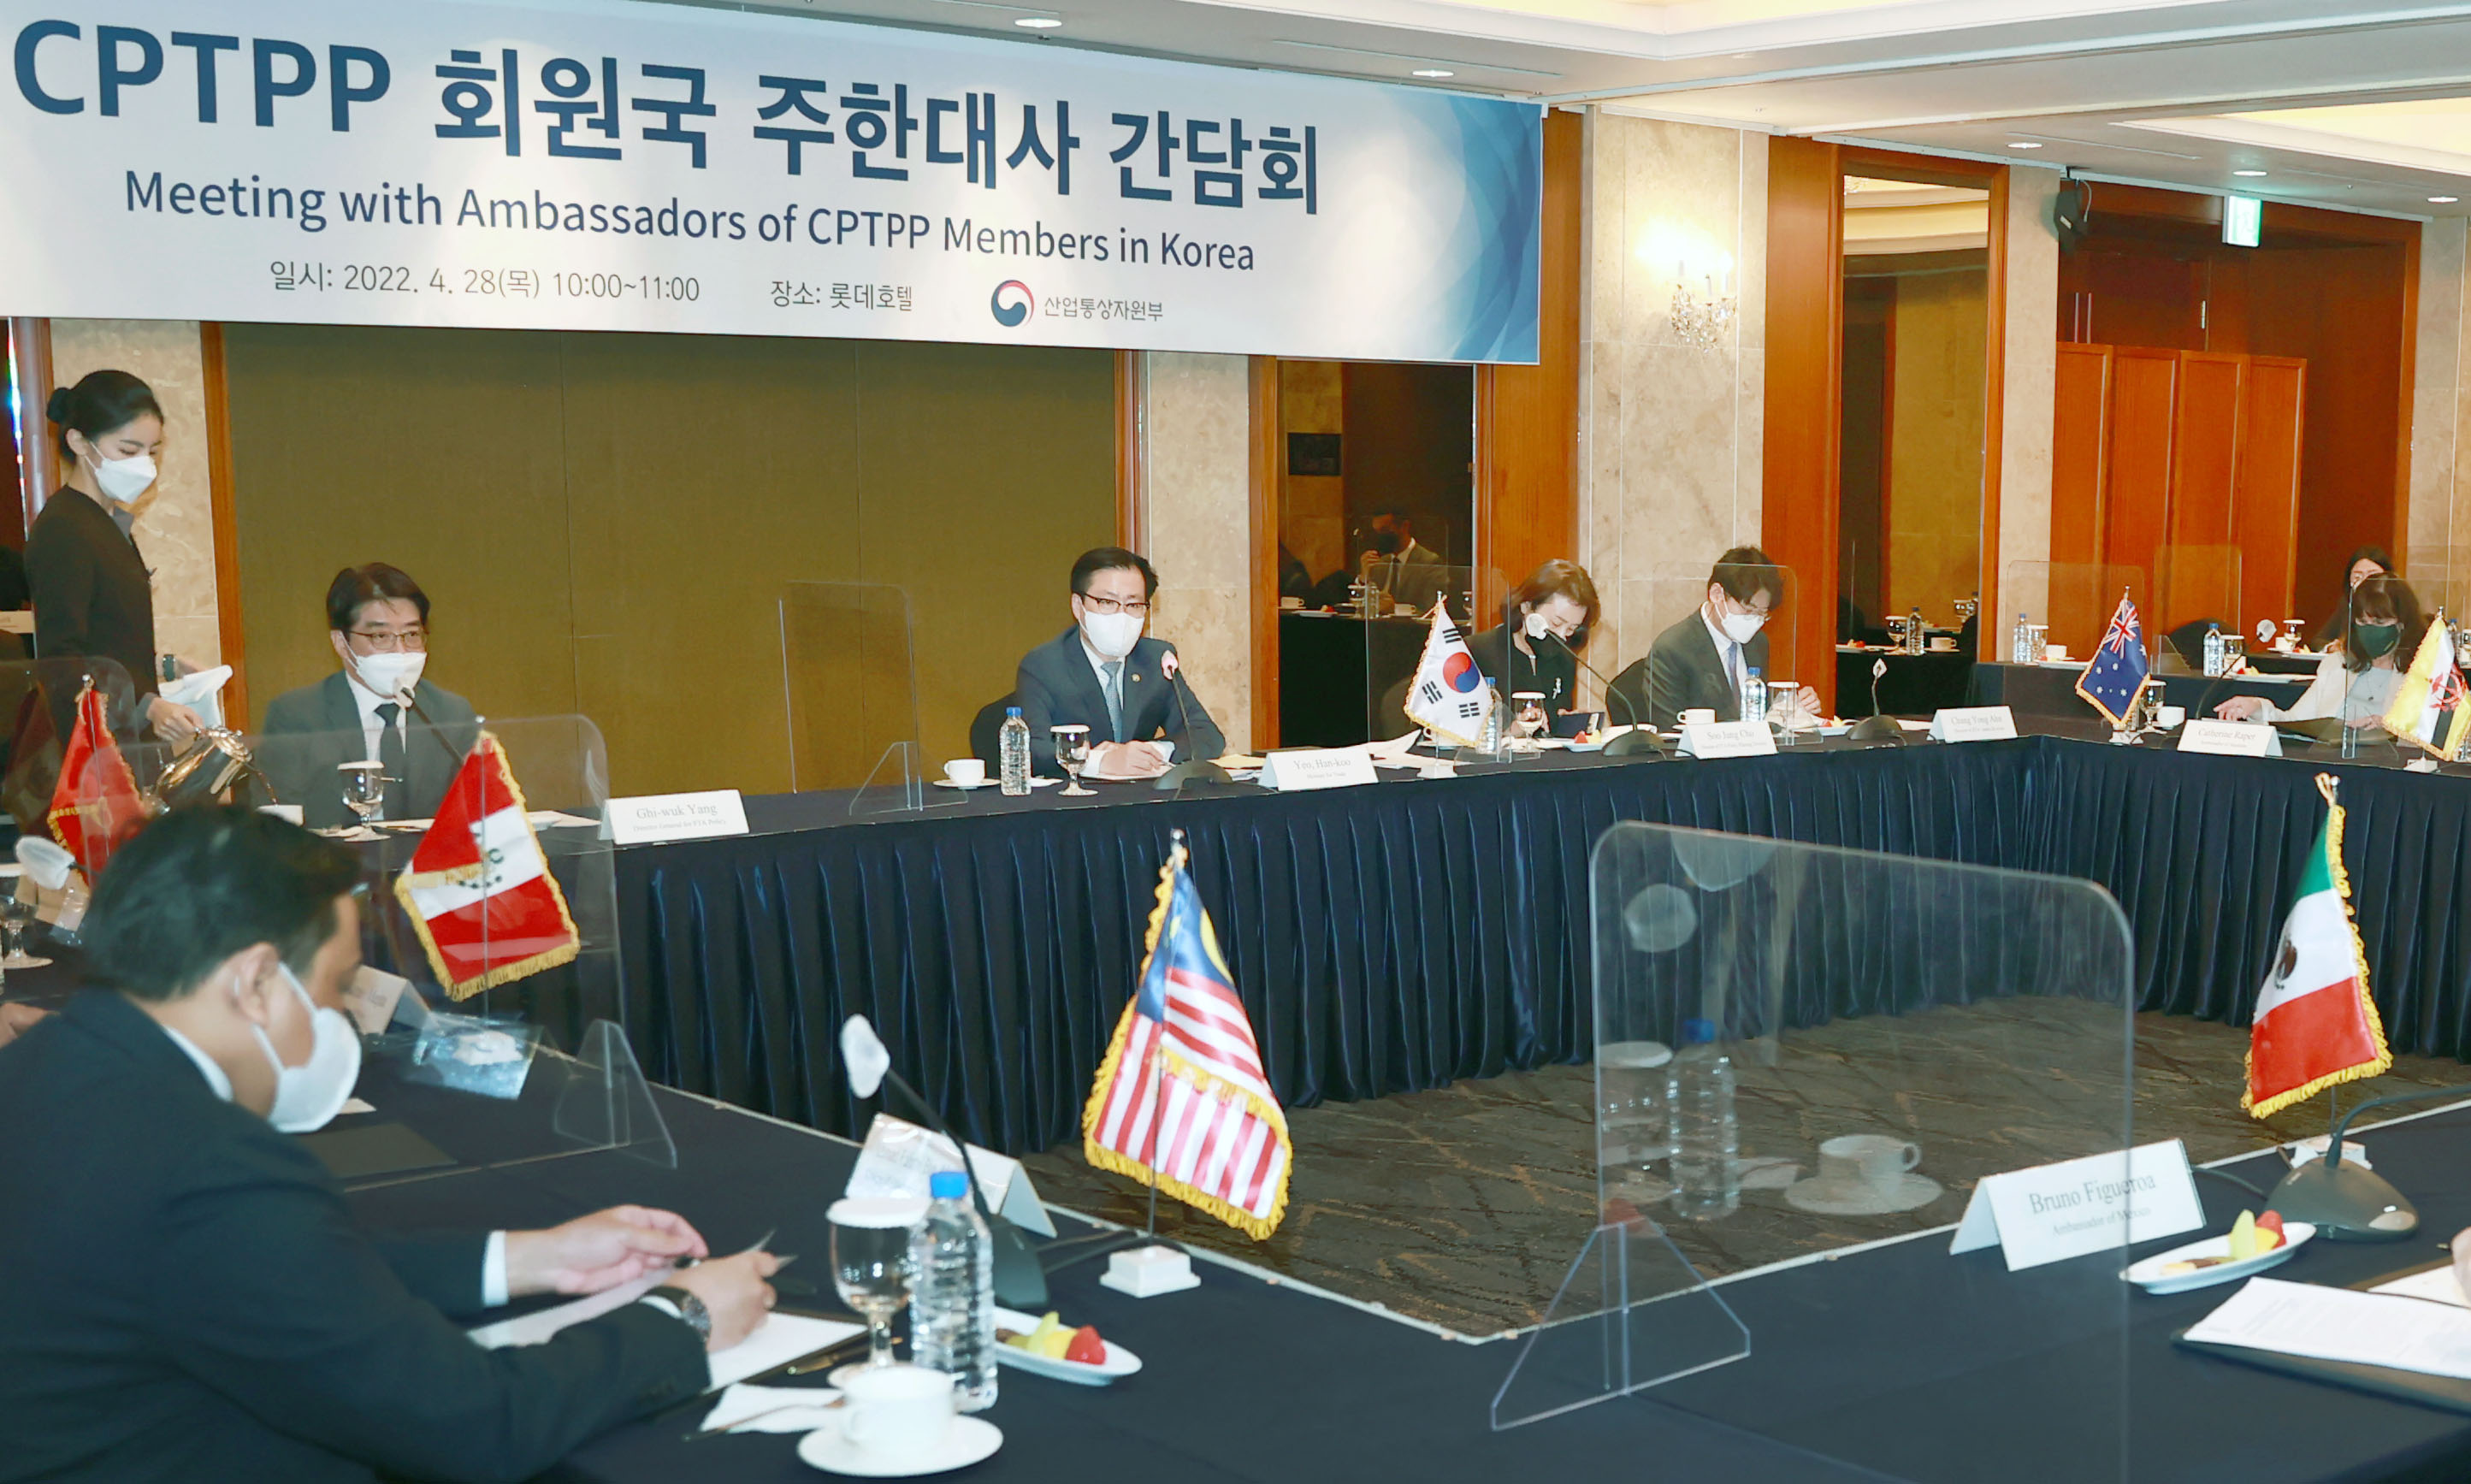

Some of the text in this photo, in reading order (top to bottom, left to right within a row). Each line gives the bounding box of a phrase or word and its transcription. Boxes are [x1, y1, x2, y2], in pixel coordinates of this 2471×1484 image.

[13, 19, 1318, 216] CPTPP 회원국 주한대사 간담회
[126, 169, 1254, 271] Meeting with Ambassadors of CPTPP Members in Korea
[269, 261, 700, 302] 일시: 2022. 4. 28(목) 10:00~11:00
[770, 280, 912, 311] 장소: 롯데호텔
[1045, 297, 1163, 322] 산업통상자원부
[1315, 758, 1351, 768] Han-koo
[687, 803, 718, 816] Yang
[2028, 1174, 2156, 1215] Bruno Figueroa
